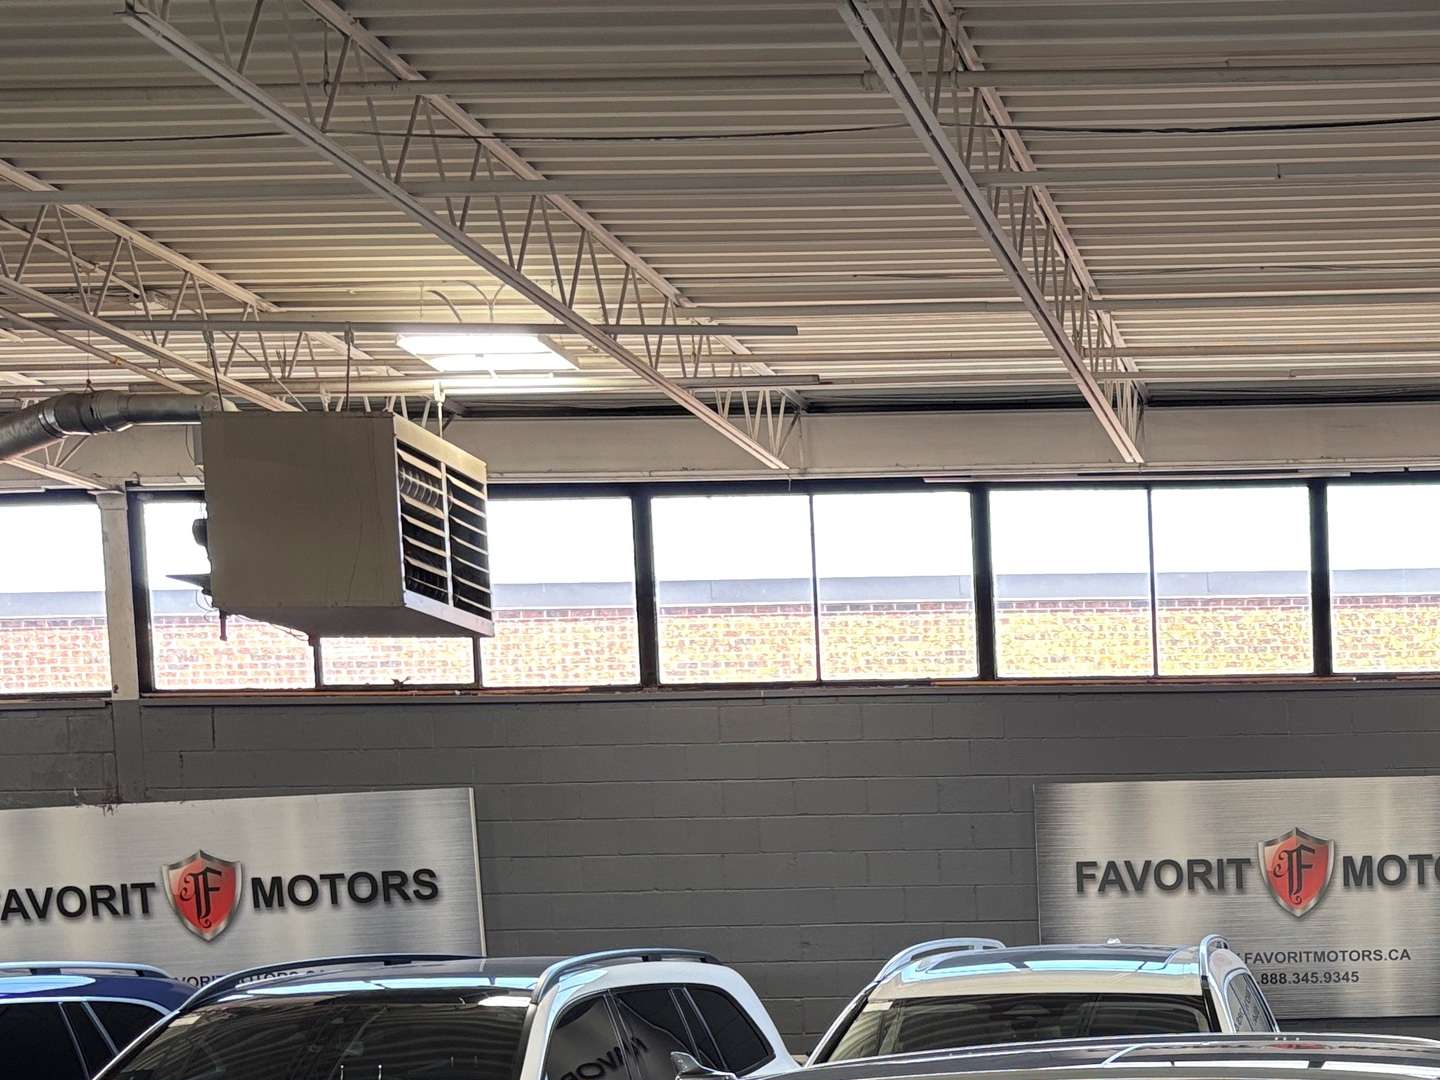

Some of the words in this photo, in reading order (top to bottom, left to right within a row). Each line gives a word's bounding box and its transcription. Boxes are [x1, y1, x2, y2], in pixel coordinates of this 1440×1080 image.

[1075, 858, 1252, 893] FAVORIT
[0, 882, 156, 921] AVORIT
[251, 868, 439, 909] MOTORS
[1237, 948, 1411, 965] FAVORITMOTORS.CA
[1257, 971, 1360, 985] .888.345.9345
